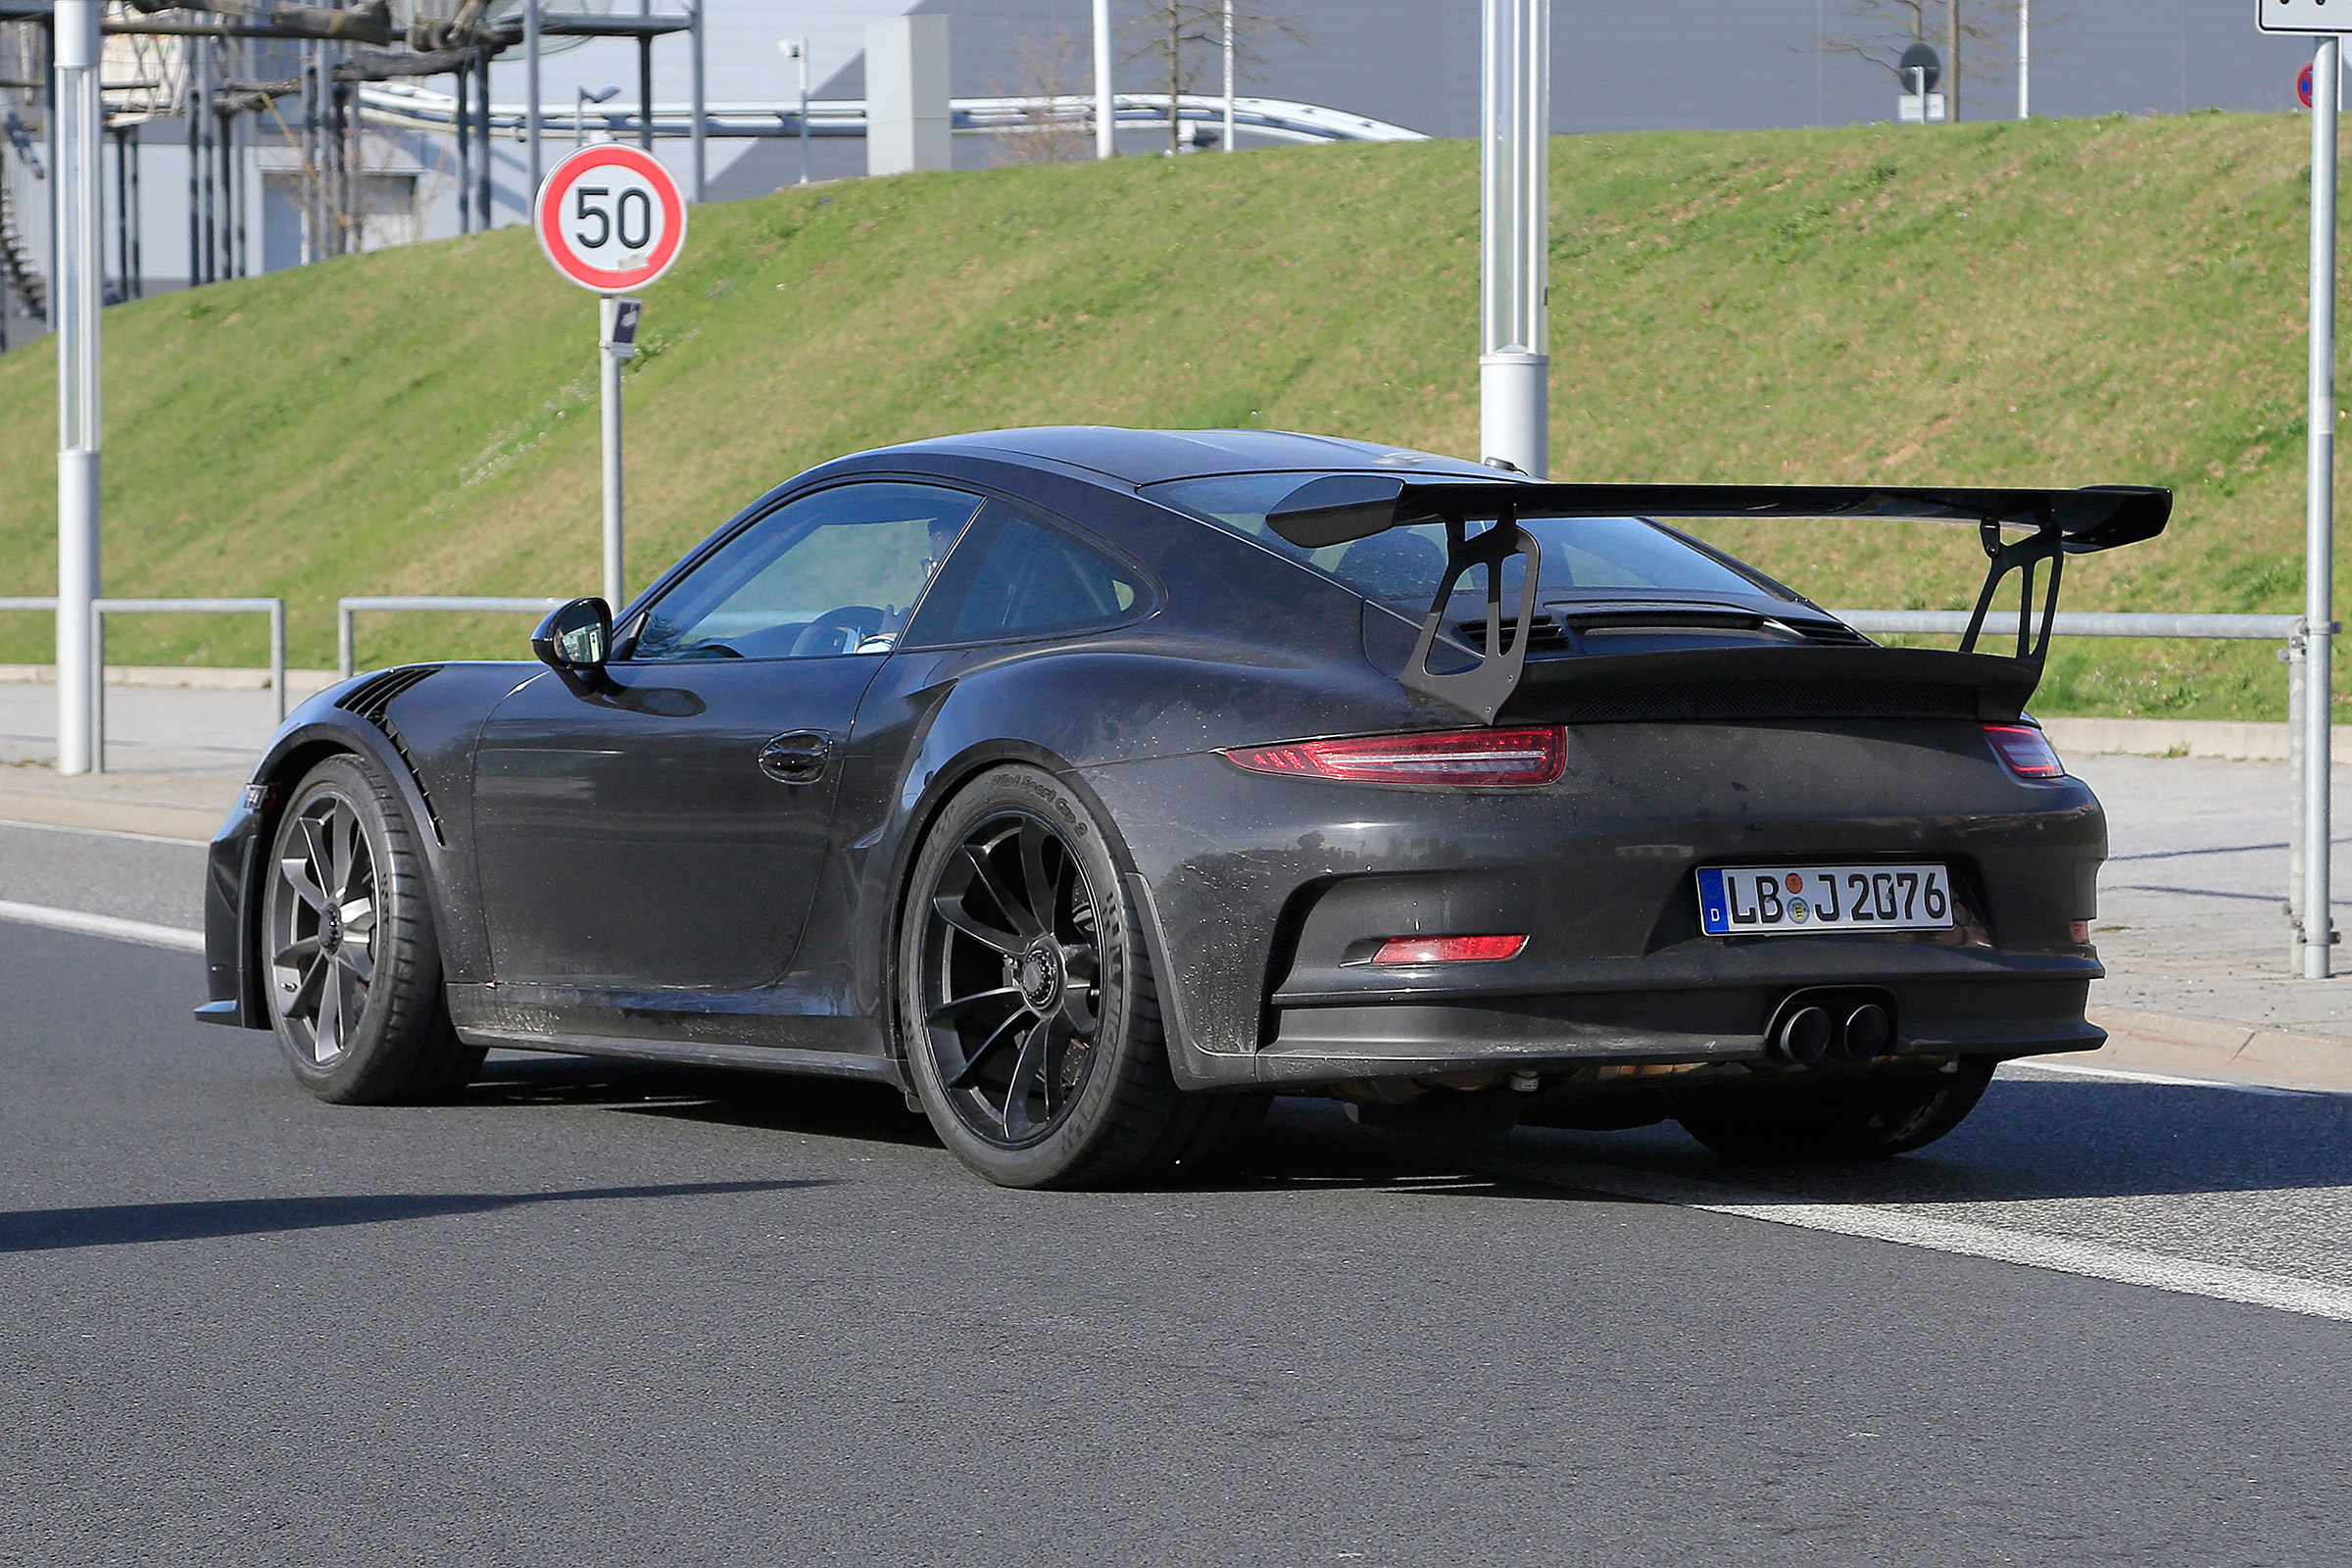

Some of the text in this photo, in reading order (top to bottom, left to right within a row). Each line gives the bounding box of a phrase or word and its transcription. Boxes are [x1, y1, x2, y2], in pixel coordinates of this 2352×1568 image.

[576, 186, 652, 249] 50
[1020, 774, 1057, 802] Sport
[1054, 797, 1077, 824] Cup
[1073, 822, 1089, 838] 2
[1710, 907, 1721, 922] D
[1727, 872, 1947, 924] LB J 2076
